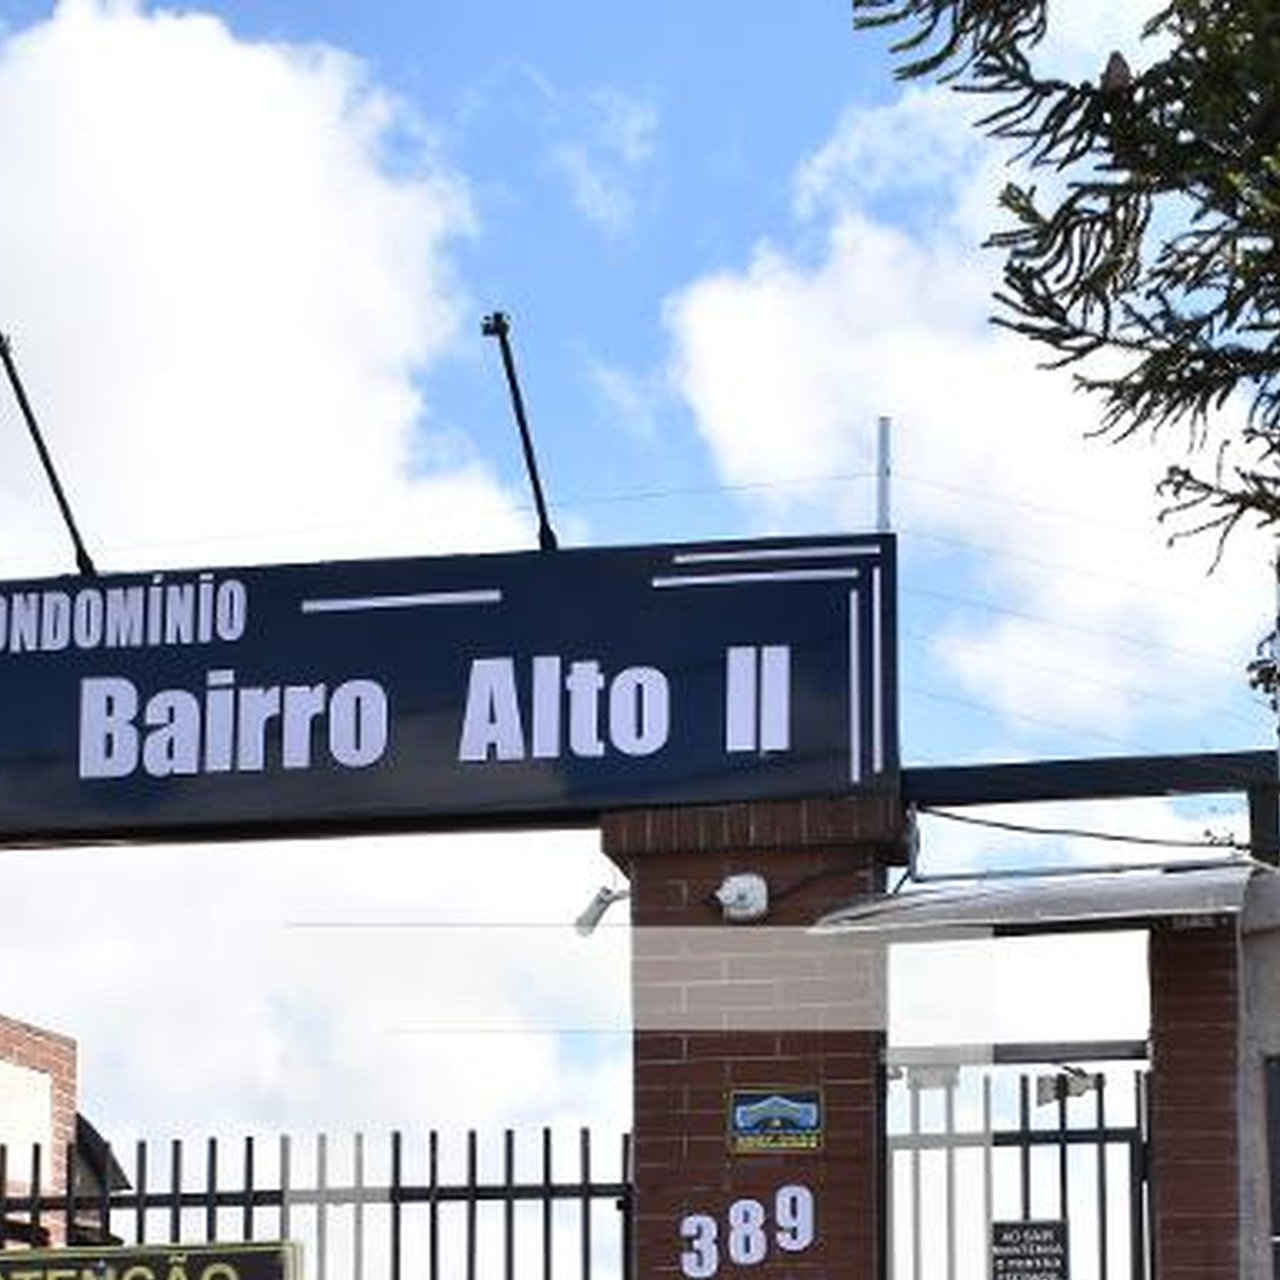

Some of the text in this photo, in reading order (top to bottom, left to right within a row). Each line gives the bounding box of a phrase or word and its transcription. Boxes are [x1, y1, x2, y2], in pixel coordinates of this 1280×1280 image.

[79, 669, 389, 779] Bairro
[458, 655, 669, 762] Alto
[725, 645, 792, 752] II
[679, 1184, 815, 1279] 389
